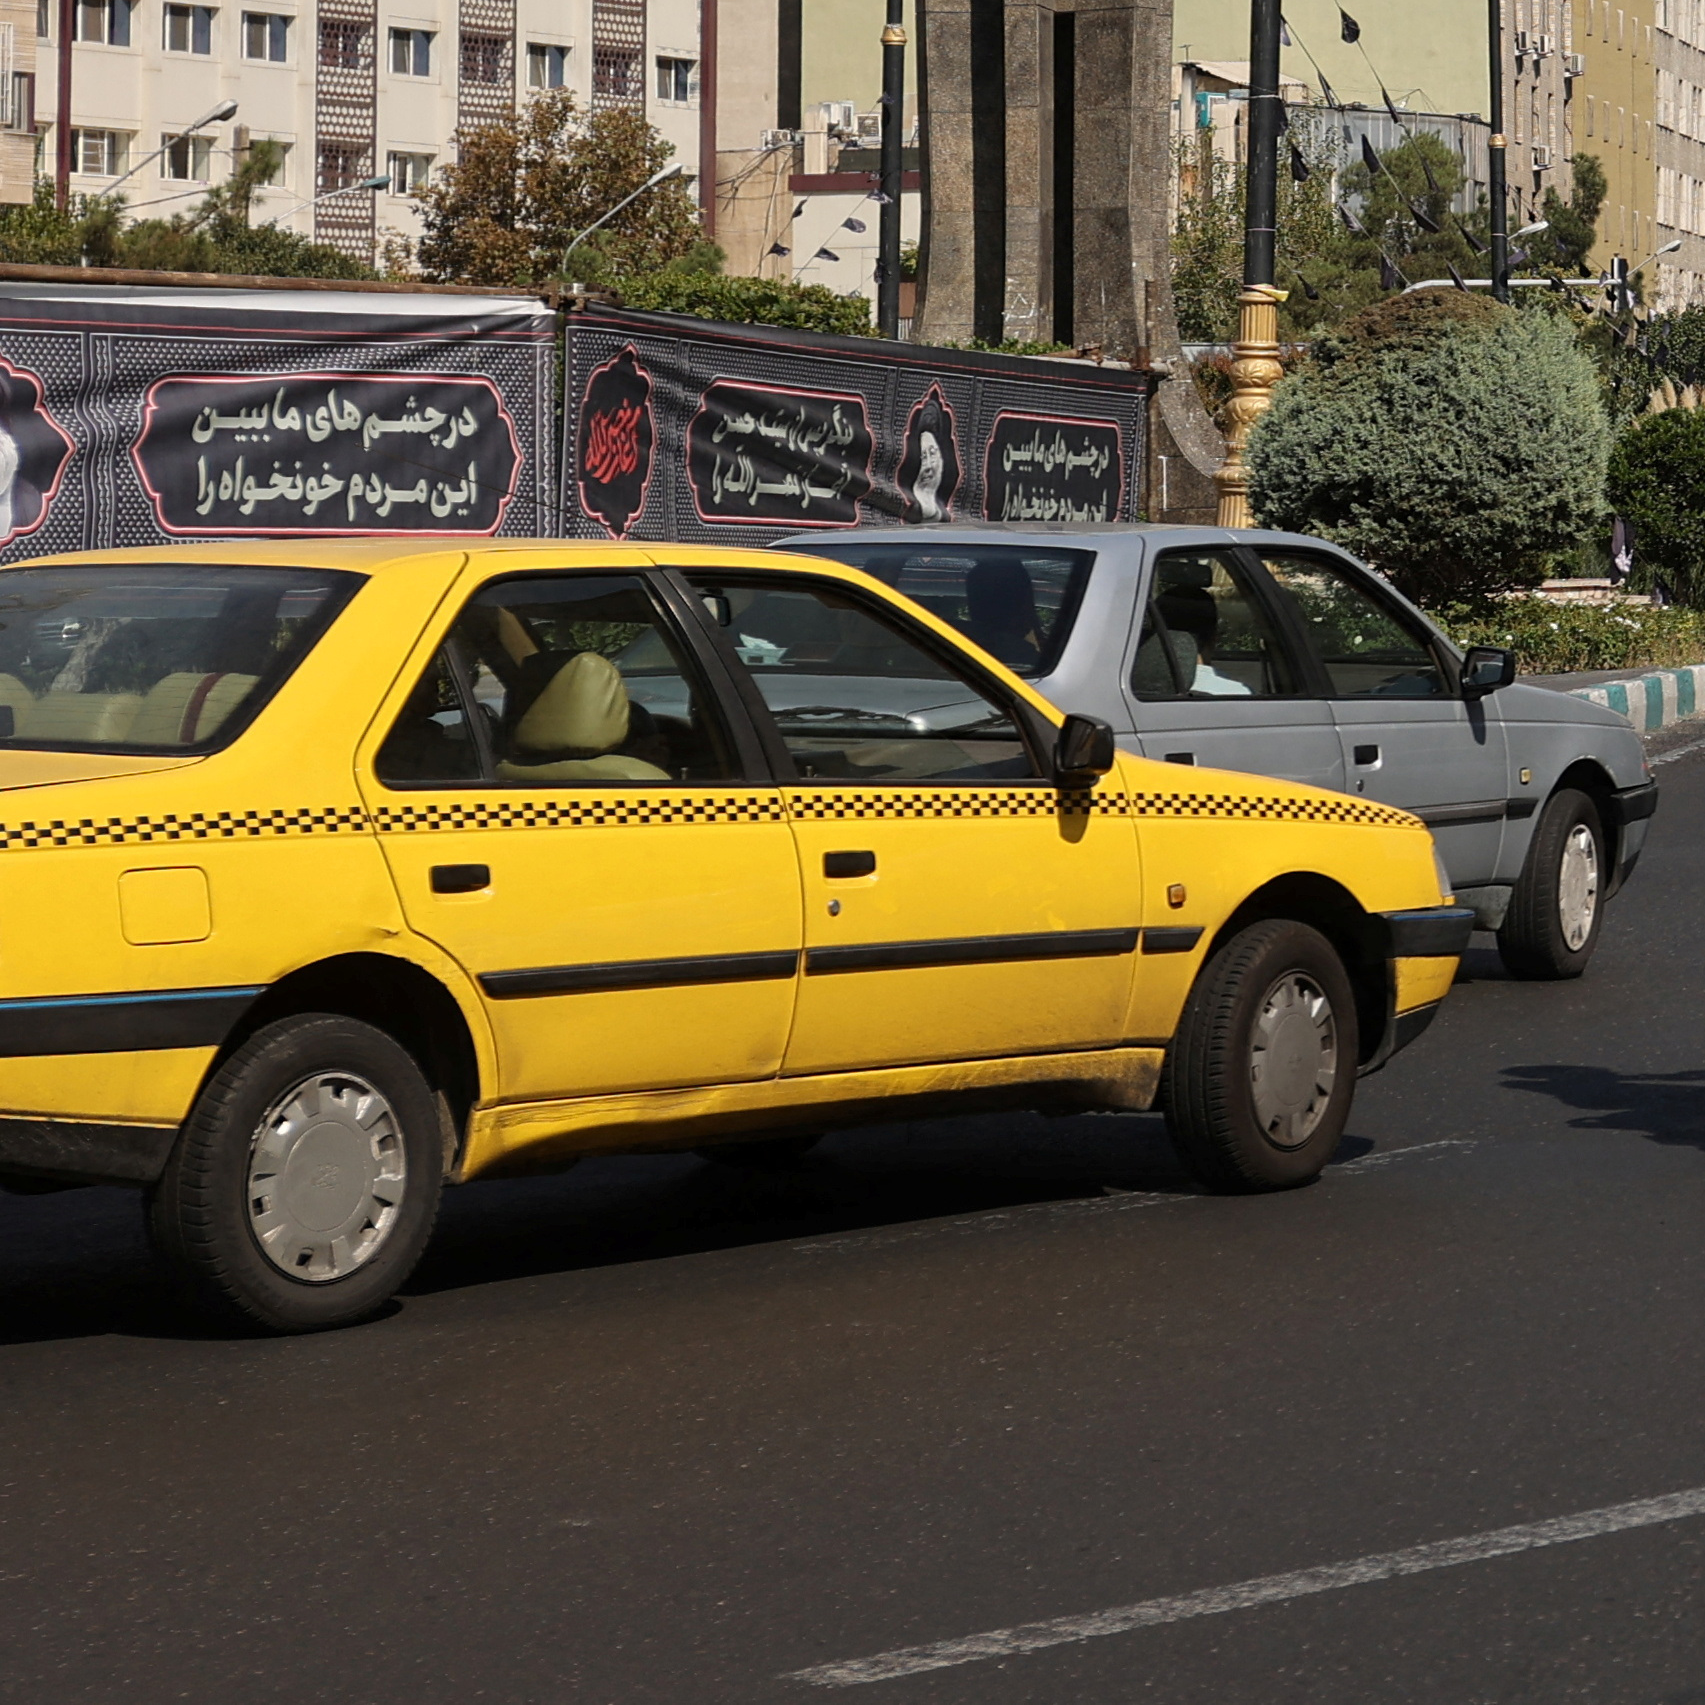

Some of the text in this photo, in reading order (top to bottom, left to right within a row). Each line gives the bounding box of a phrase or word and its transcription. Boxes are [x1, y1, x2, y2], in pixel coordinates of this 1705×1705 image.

[192, 387, 478, 451] در چشم های ما ببین
[195, 454, 477, 521] این مردم خونخواه را
